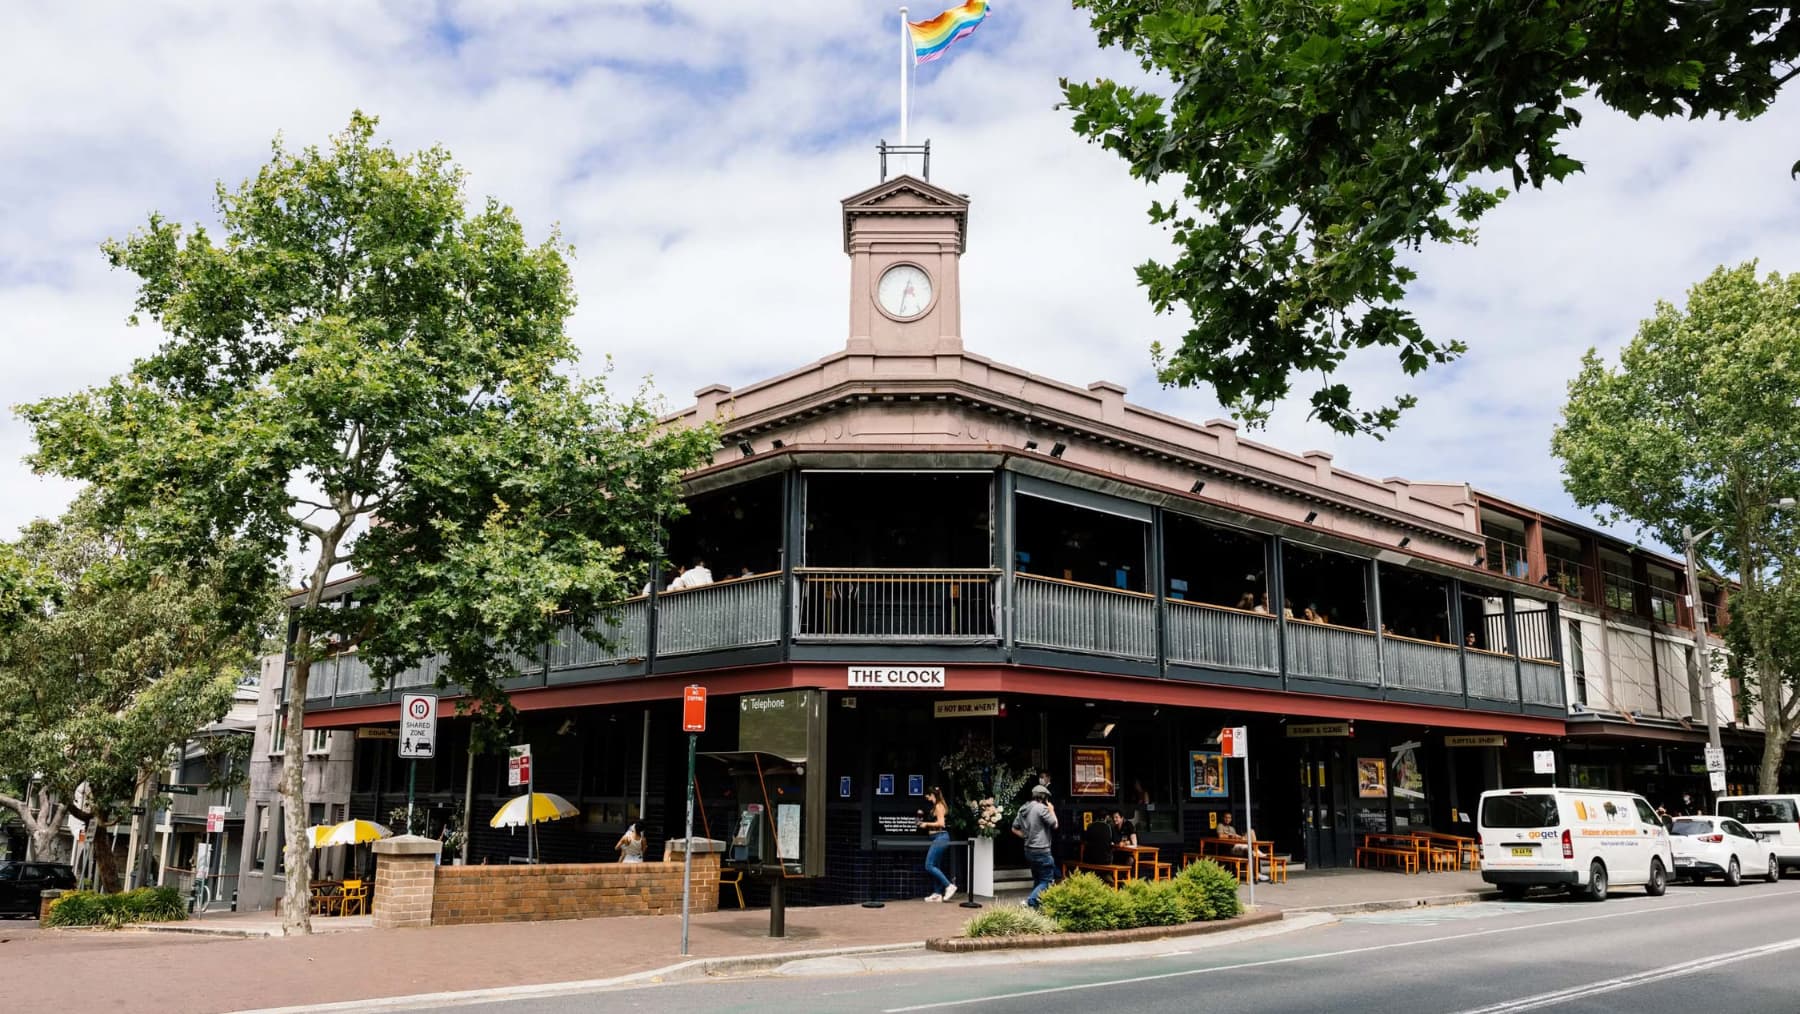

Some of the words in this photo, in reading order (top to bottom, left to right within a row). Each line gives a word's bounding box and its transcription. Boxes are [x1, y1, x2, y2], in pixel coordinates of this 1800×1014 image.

[851, 670, 882, 683] THE
[887, 670, 941, 683] CLOCK
[415, 704, 425, 714] 10
[750, 697, 785, 712] Telephone
[1528, 830, 1559, 839] goget
